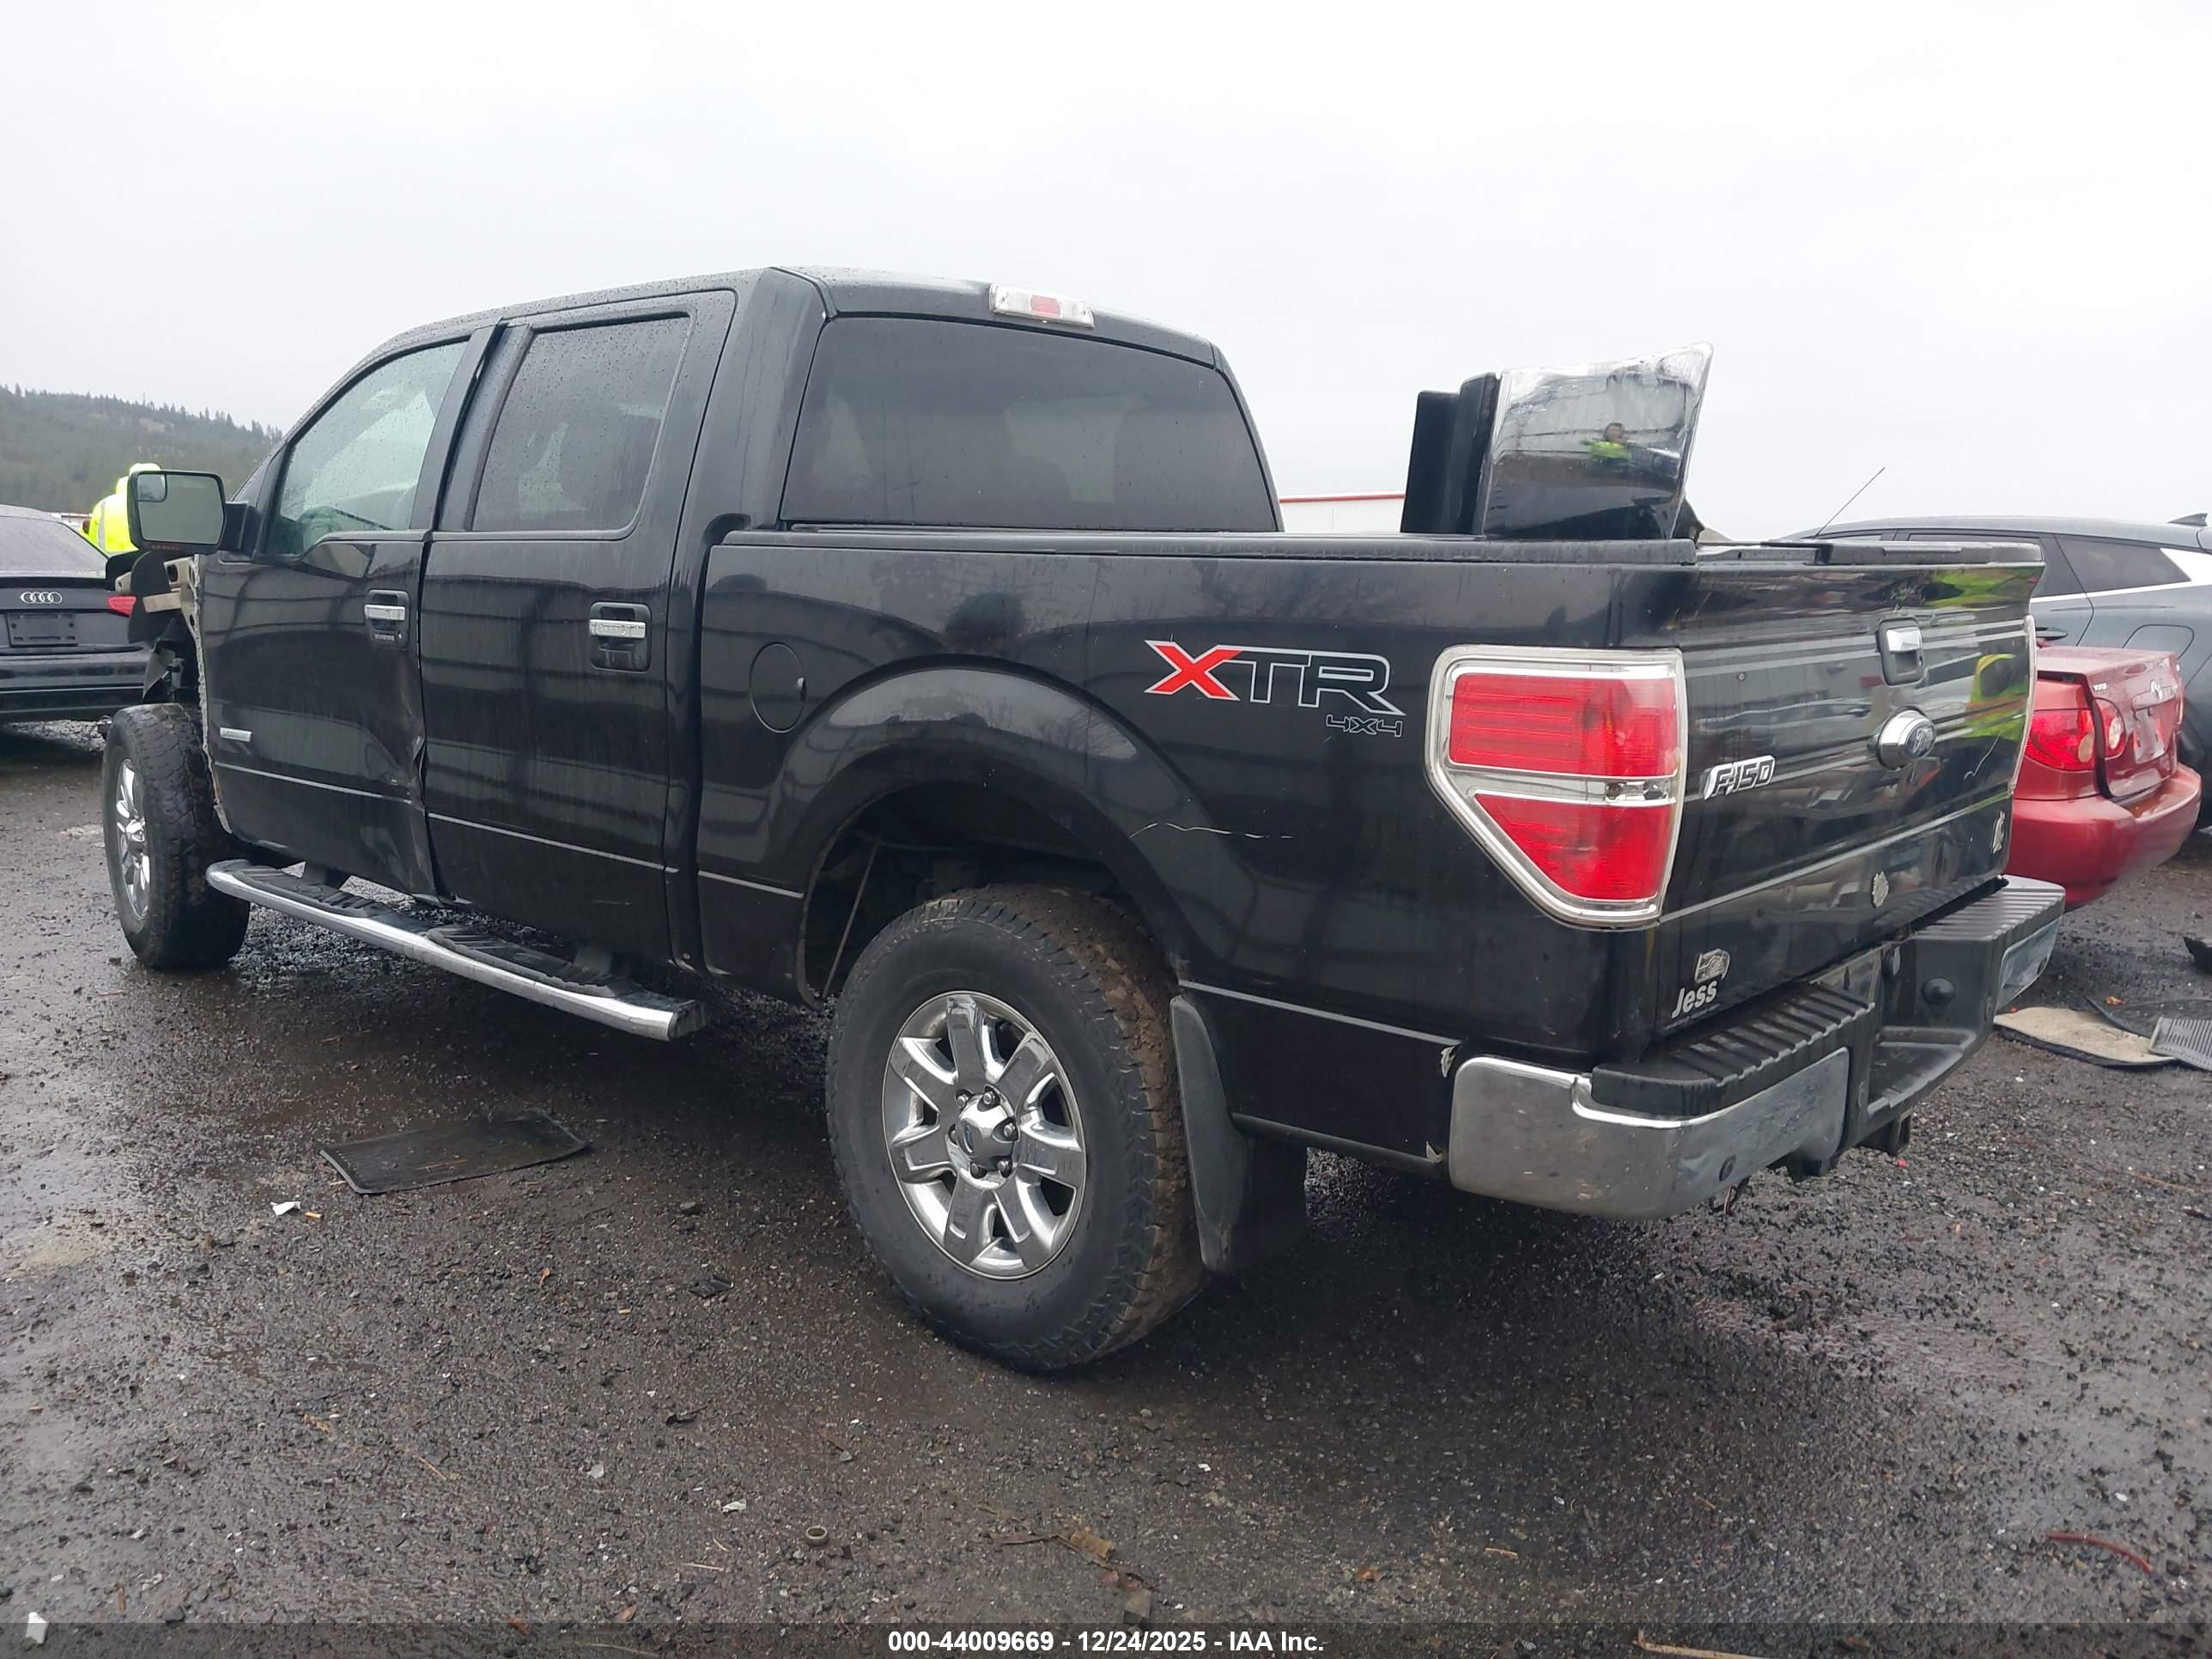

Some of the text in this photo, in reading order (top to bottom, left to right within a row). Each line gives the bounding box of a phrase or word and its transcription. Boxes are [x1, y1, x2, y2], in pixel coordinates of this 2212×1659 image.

[1144, 640, 1407, 716] XTR
[1704, 755, 1776, 800] F-150
[1670, 980, 1718, 1019] Jess
